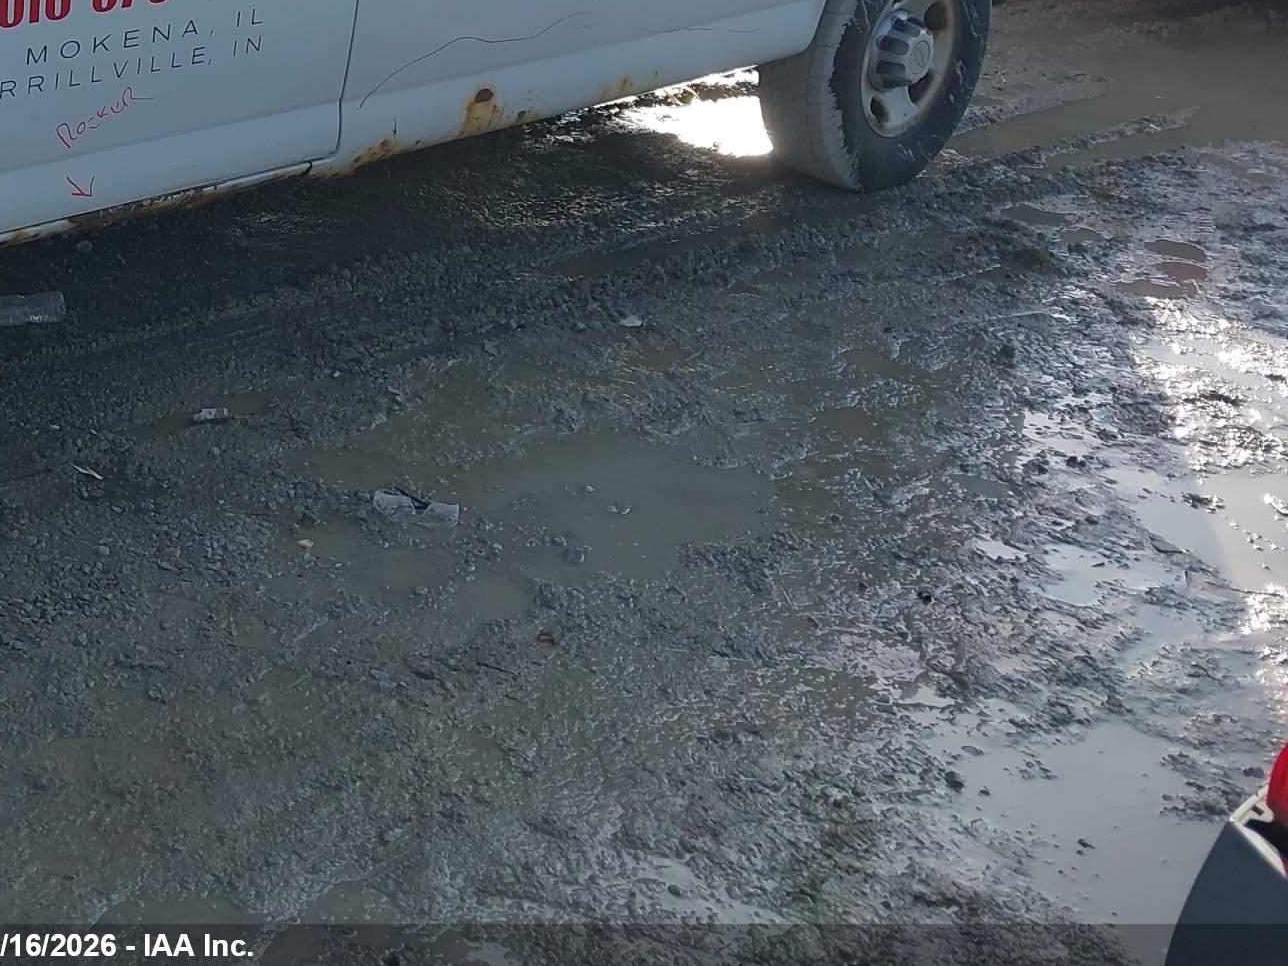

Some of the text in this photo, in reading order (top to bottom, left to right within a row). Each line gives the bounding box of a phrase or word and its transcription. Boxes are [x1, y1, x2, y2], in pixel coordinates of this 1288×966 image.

[26, 8, 264, 66] MOKENA, IL
[232, 35, 263, 58] IN
